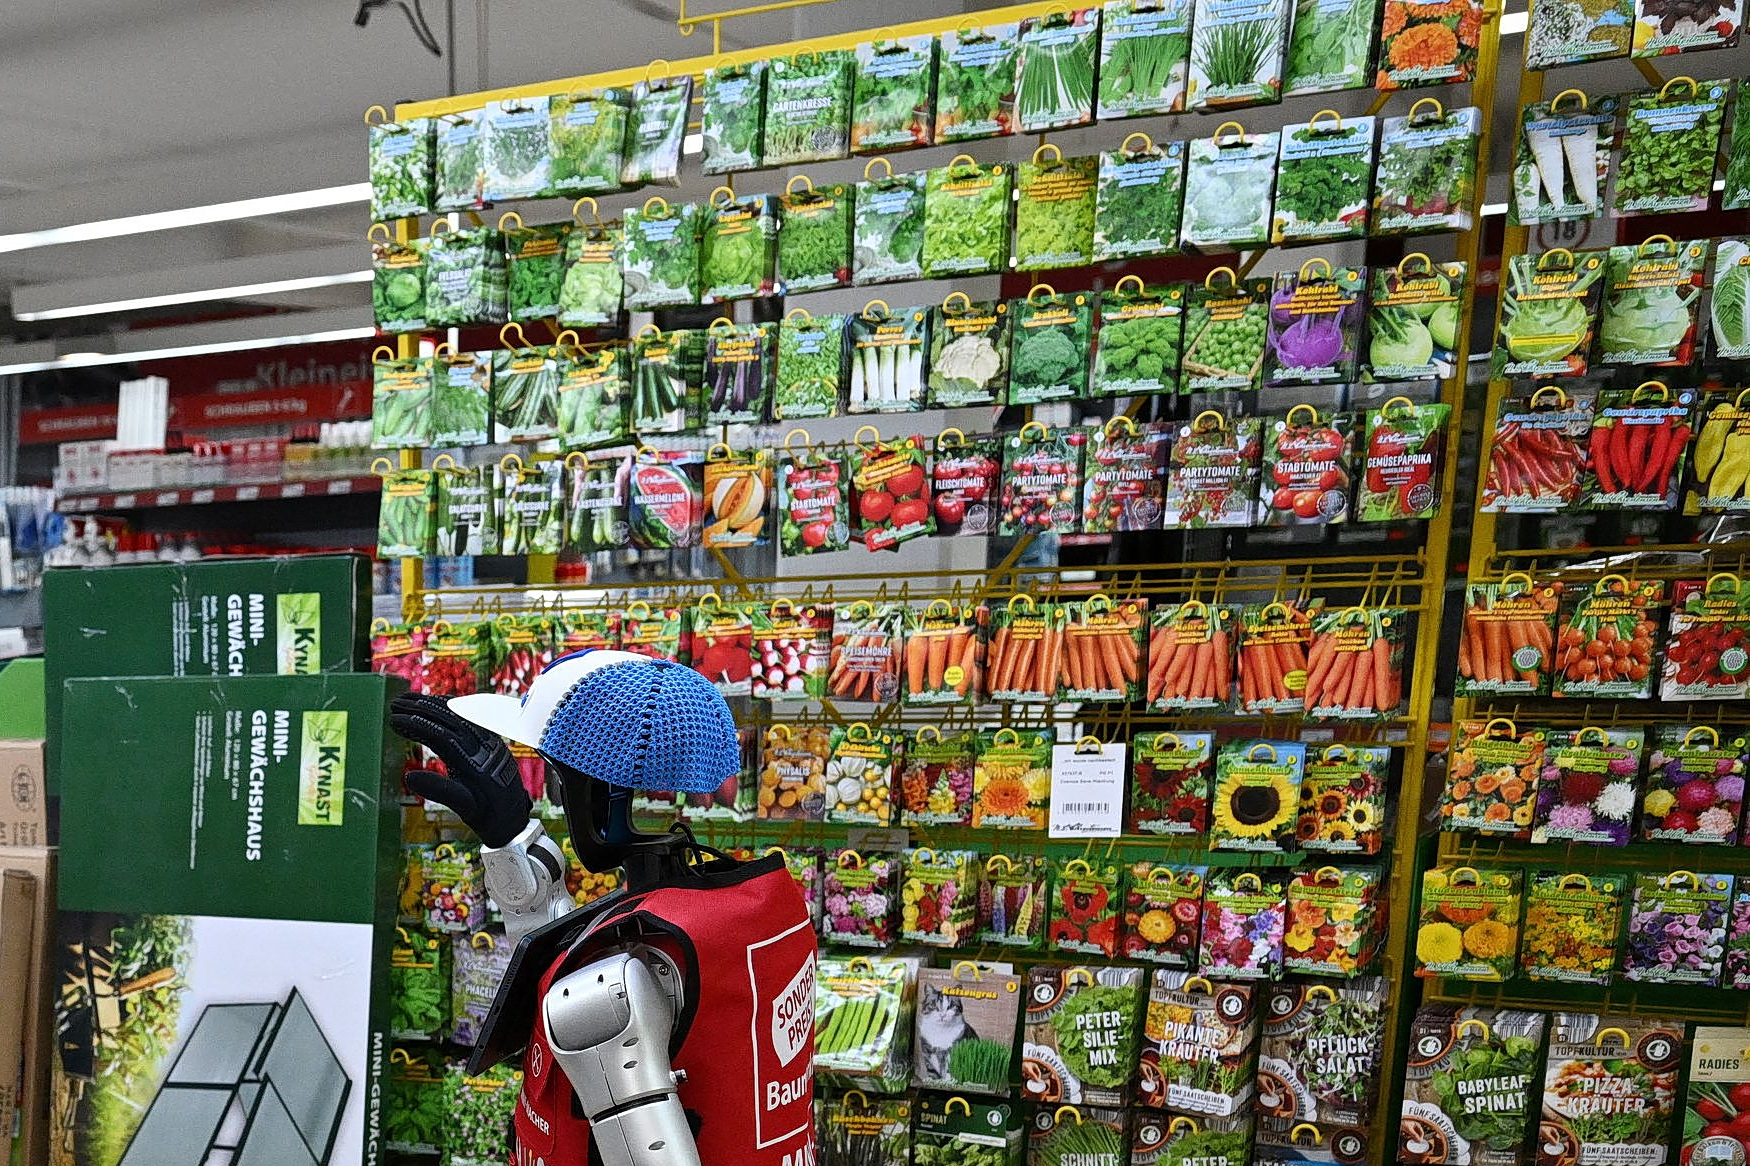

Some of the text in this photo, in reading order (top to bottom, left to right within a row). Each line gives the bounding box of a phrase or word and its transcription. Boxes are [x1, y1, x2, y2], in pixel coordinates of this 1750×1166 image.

[772, 97, 833, 113] GARTENKRESSE
[1636, 103, 1718, 118] Brunnenkresse
[1631, 261, 1679, 274] Kohlrabi
[1532, 273, 1578, 285] Kohlrabi
[1295, 284, 1338, 296] Kohlrabi
[1396, 281, 1439, 292] Kohlrabi
[1603, 407, 1688, 418] Gewürzpaprika
[1277, 460, 1336, 474] STABTOMATE
[1367, 453, 1432, 469] GEMÜSEPAPRIKA
[1095, 468, 1153, 482] PARTYTOMATE
[1180, 466, 1241, 477] PARTYTOMATE
[935, 476, 985, 490] FLEISCHTOMATE
[1012, 473, 1067, 486] PARTYTOMATE
[1493, 600, 1532, 610] Möhren
[1590, 600, 1631, 609] Möhren
[1704, 600, 1738, 608] Radies
[249, 593, 264, 647] MINI-
[1012, 618, 1046, 628] Möhren
[1087, 616, 1120, 626] Möhren
[1174, 623, 1210, 632] Möhren
[1248, 622, 1311, 633] Speisemöhren
[1334, 630, 1371, 639] Möhren
[840, 646, 893, 657] SPEISEMÖHRE
[273, 710, 290, 763] MINI-
[776, 766, 811, 777] PHYSALIS
[246, 709, 268, 861] GEWÄCHSHAUS
[315, 746, 341, 822] KYNAST
[465, 984, 497, 1001] PHACELI
[777, 962, 814, 1030] SONDER
[942, 986, 998, 999] Katzengras
[1153, 991, 1201, 1005] TOPFKULTUR
[1076, 1010, 1124, 1030] PETER-
[1083, 1032, 1124, 1048] SILIE-
[1164, 1021, 1221, 1045] PIKANTE
[1160, 1039, 1220, 1064] KRÄUTER
[1308, 1036, 1370, 1055] PFLÜCK-
[1555, 1045, 1615, 1057] TOPFKULTUR
[1089, 1049, 1117, 1066] MIX
[1699, 1058, 1740, 1070] RADIES
[1316, 1057, 1364, 1074] SALAT
[766, 1054, 814, 1111] Baum
[1458, 1074, 1530, 1096] BABYLEAF-
[1583, 1075, 1639, 1094] PIZZA-
[1464, 1092, 1526, 1115] SPINAT
[1567, 1095, 1646, 1117] KRÄUTER
[920, 1113, 948, 1126] SPINAT
